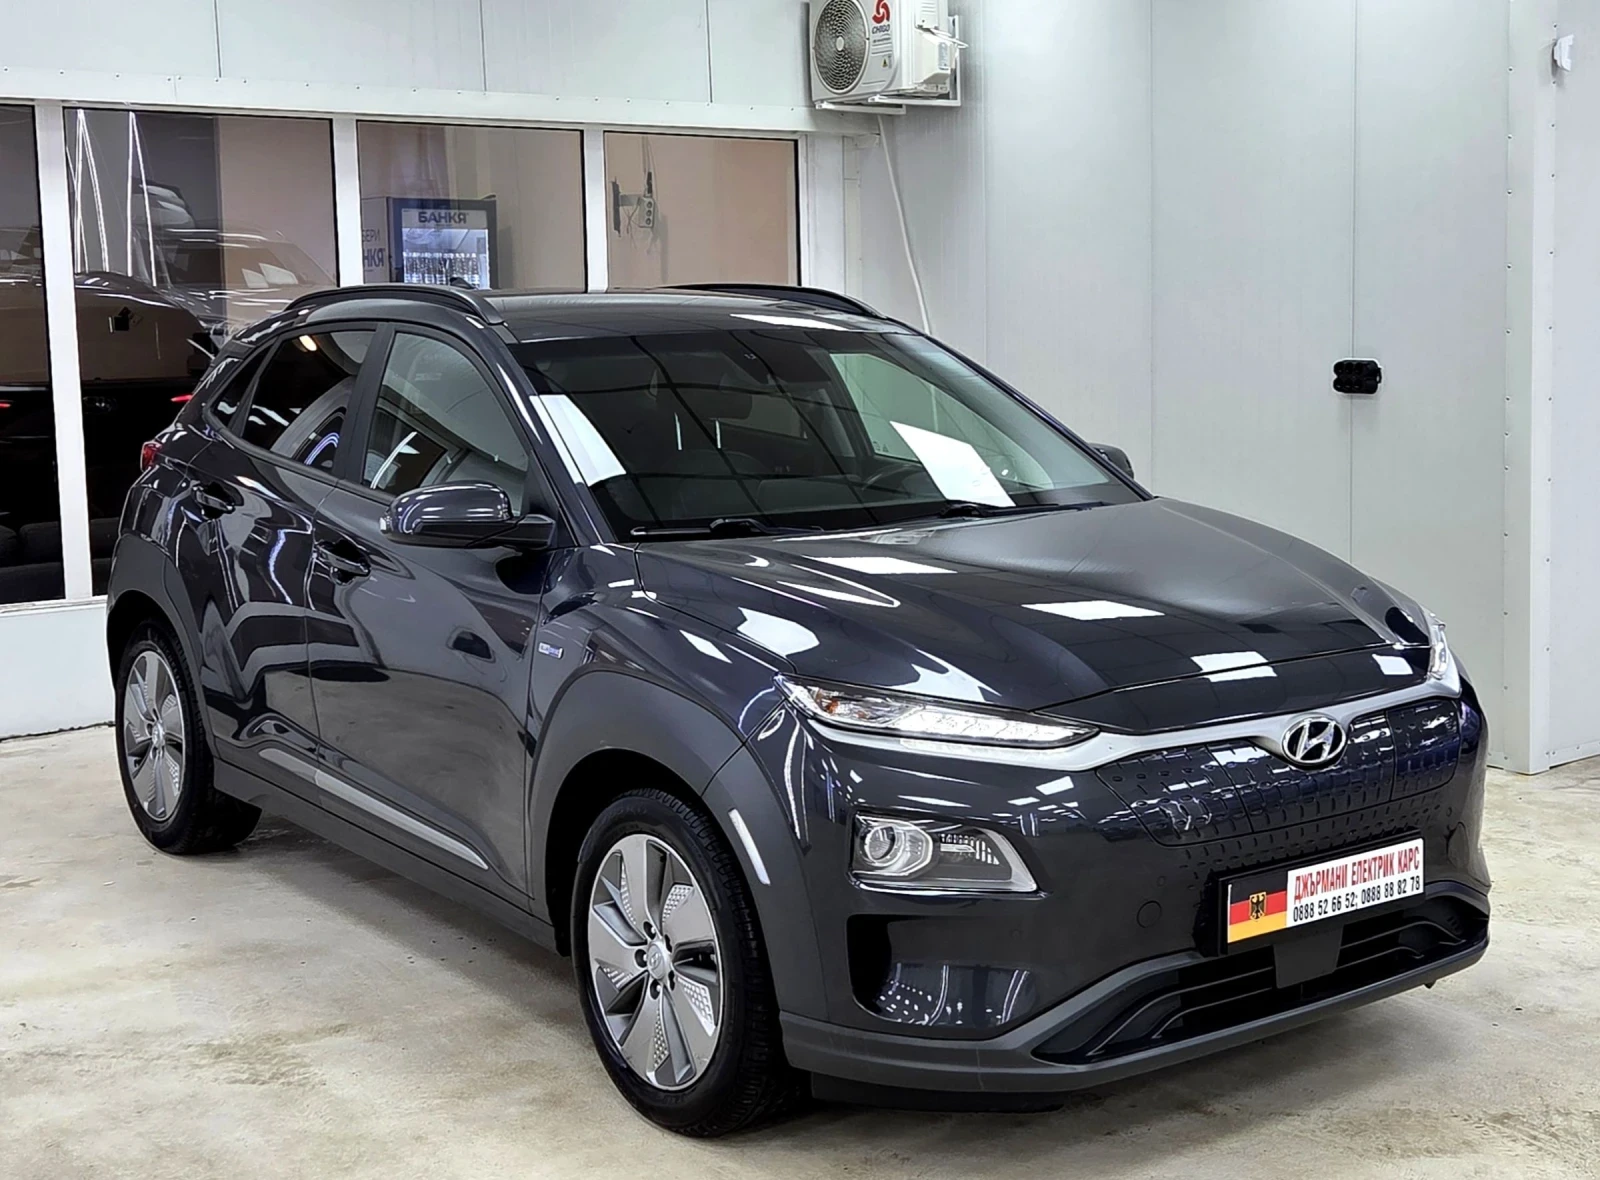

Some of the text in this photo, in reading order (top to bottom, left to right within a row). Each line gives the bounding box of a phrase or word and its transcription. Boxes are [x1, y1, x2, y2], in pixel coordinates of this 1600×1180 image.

[418, 211, 467, 224] БАНКЯ
[1293, 875, 1421, 922] 0888 52 66 52; 0888 88 82 78
[1294, 846, 1420, 904] ДЖЪРМАНИ ЕЛЕКТРИК КАРС
